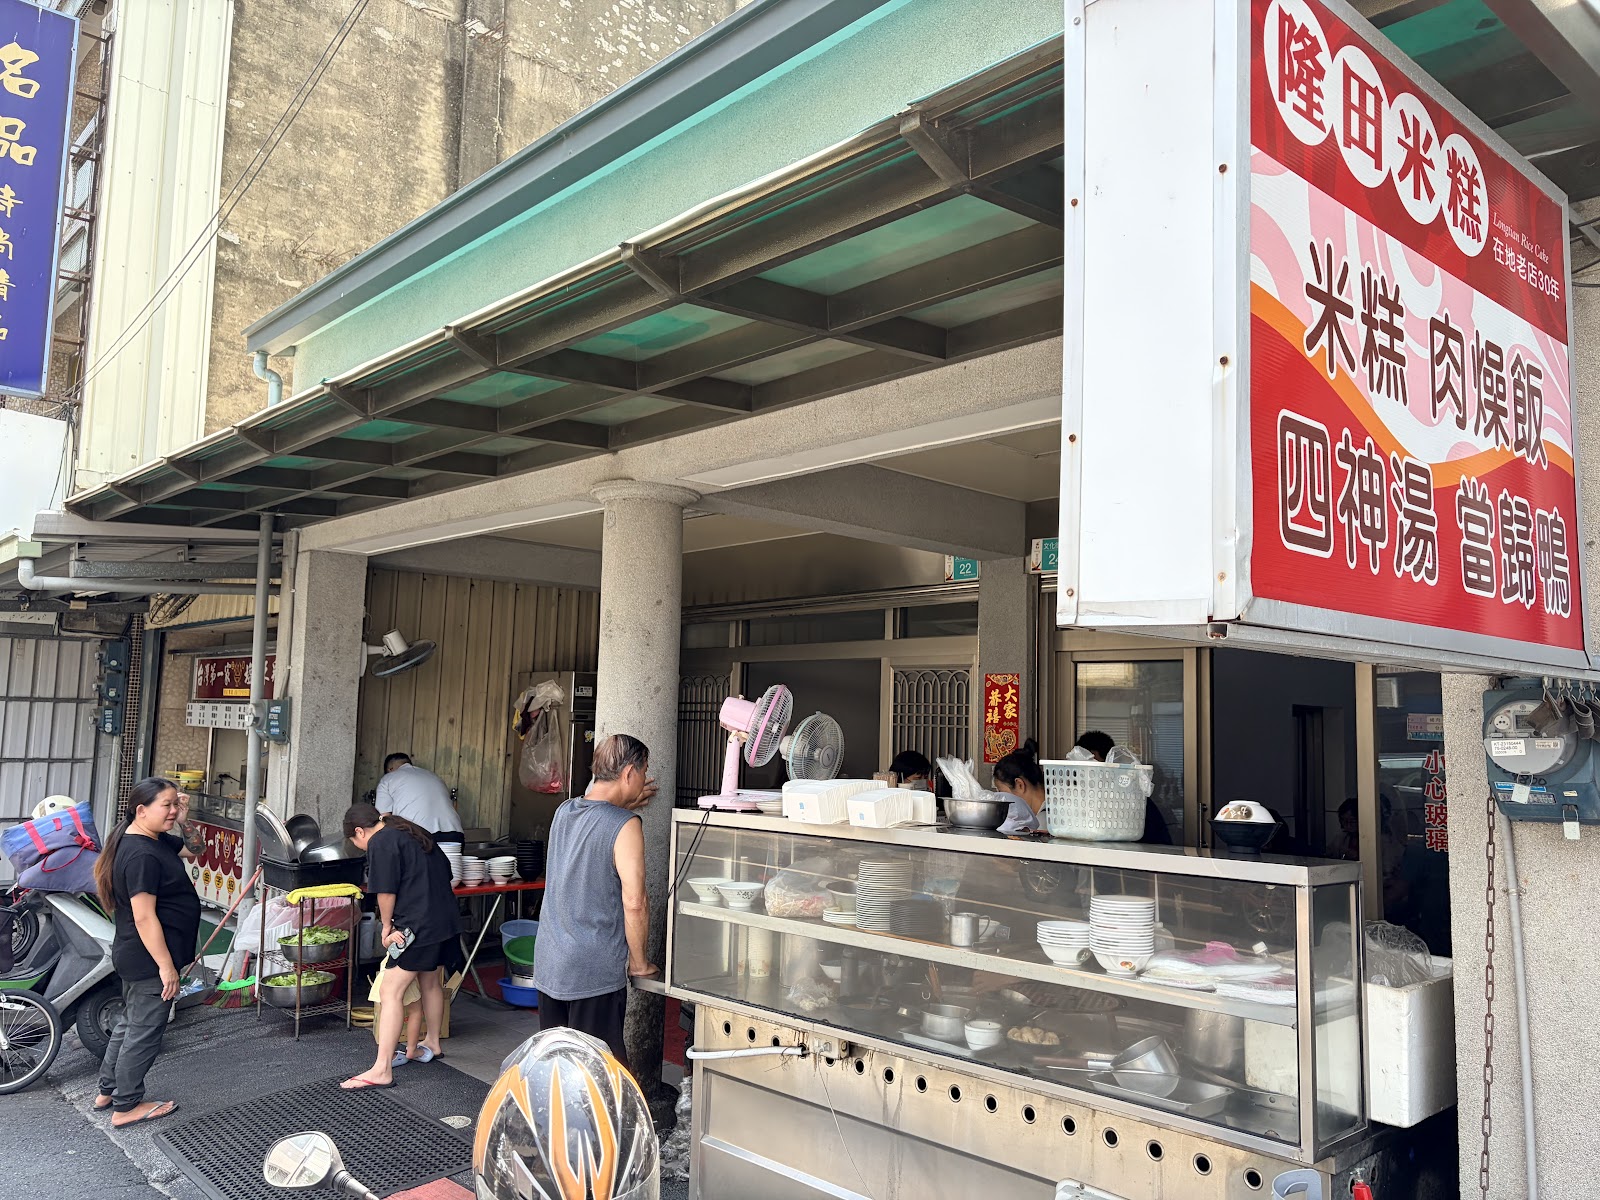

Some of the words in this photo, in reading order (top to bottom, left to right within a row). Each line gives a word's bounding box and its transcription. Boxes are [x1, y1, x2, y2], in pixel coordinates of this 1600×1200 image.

[1277, 3, 1482, 243] 隆田米糕
[1493, 212, 1520, 243] Longtian
[1521, 233, 1534, 253] Rice
[1534, 244, 1549, 264] Cake
[1493, 236, 1560, 302] 在地老店30年
[1305, 241, 1408, 407] 米糕
[1428, 312, 1548, 468] 肉燥飯
[1277, 409, 1438, 586] 四神湯
[1456, 475, 1572, 619] 當歸鴨
[959, 562, 972, 575] 22
[985, 688, 1002, 723] 恭禧
[1003, 684, 1018, 719] 大家
[1424, 750, 1449, 852] 小心玻璃
